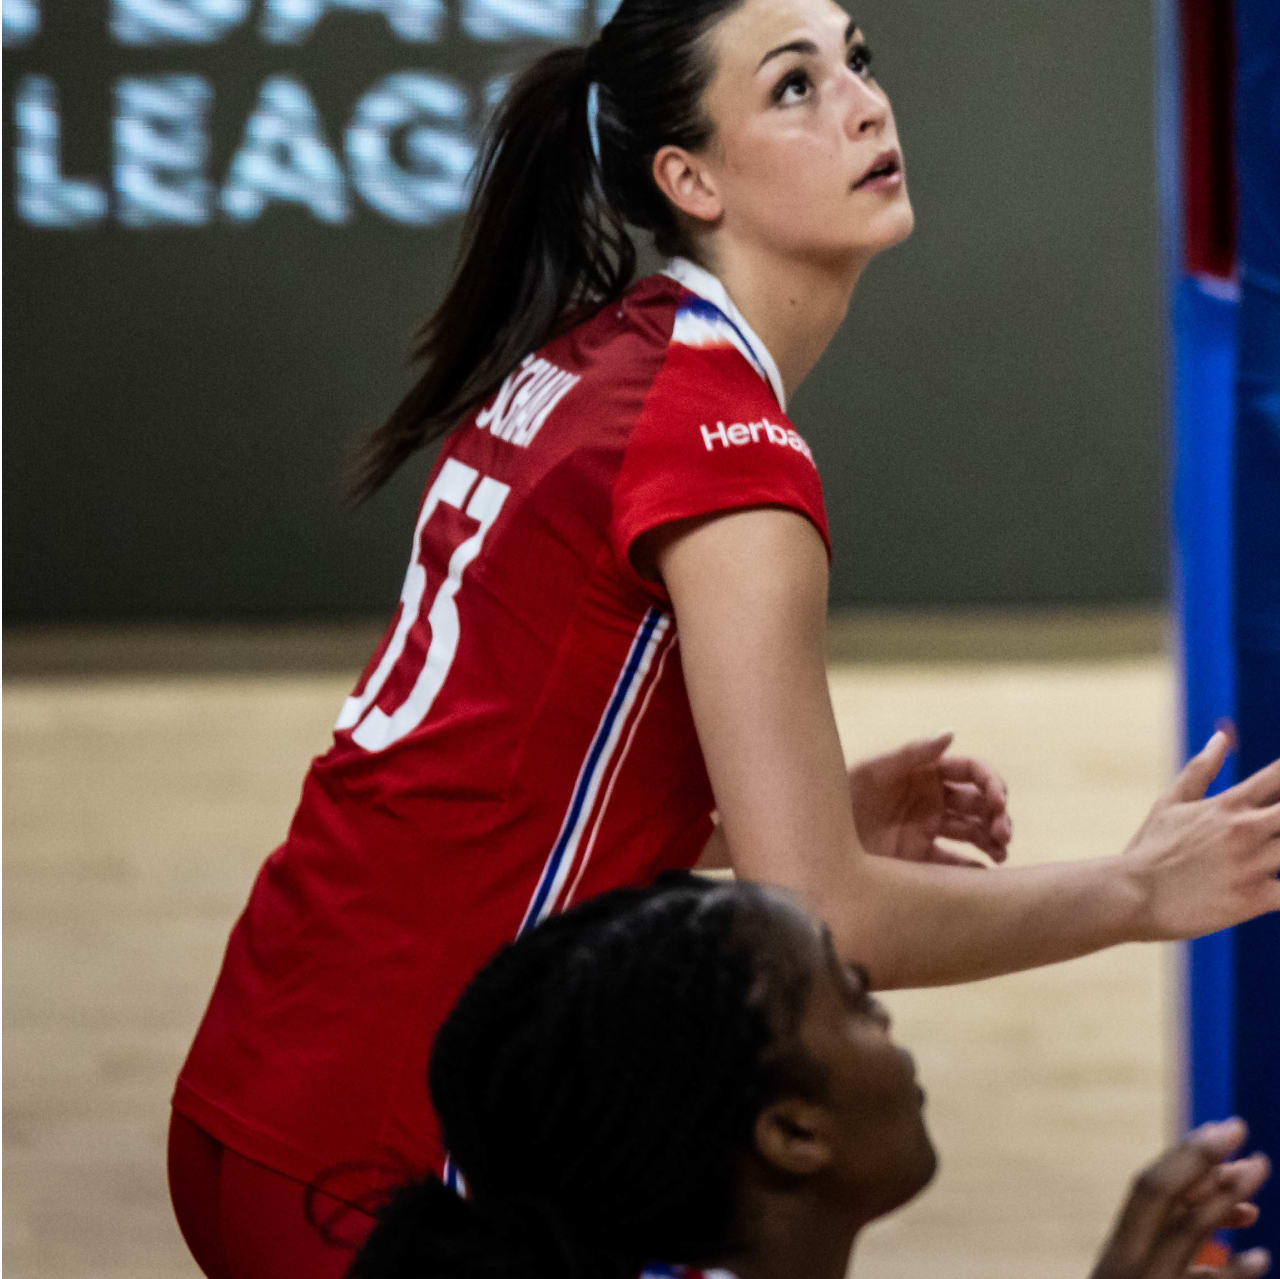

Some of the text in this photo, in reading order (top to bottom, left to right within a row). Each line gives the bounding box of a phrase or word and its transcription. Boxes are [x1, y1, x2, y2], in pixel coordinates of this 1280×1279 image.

[14, 72, 512, 228] LEAG
[699, 417, 816, 466] Herba
[333, 457, 511, 753] 53
